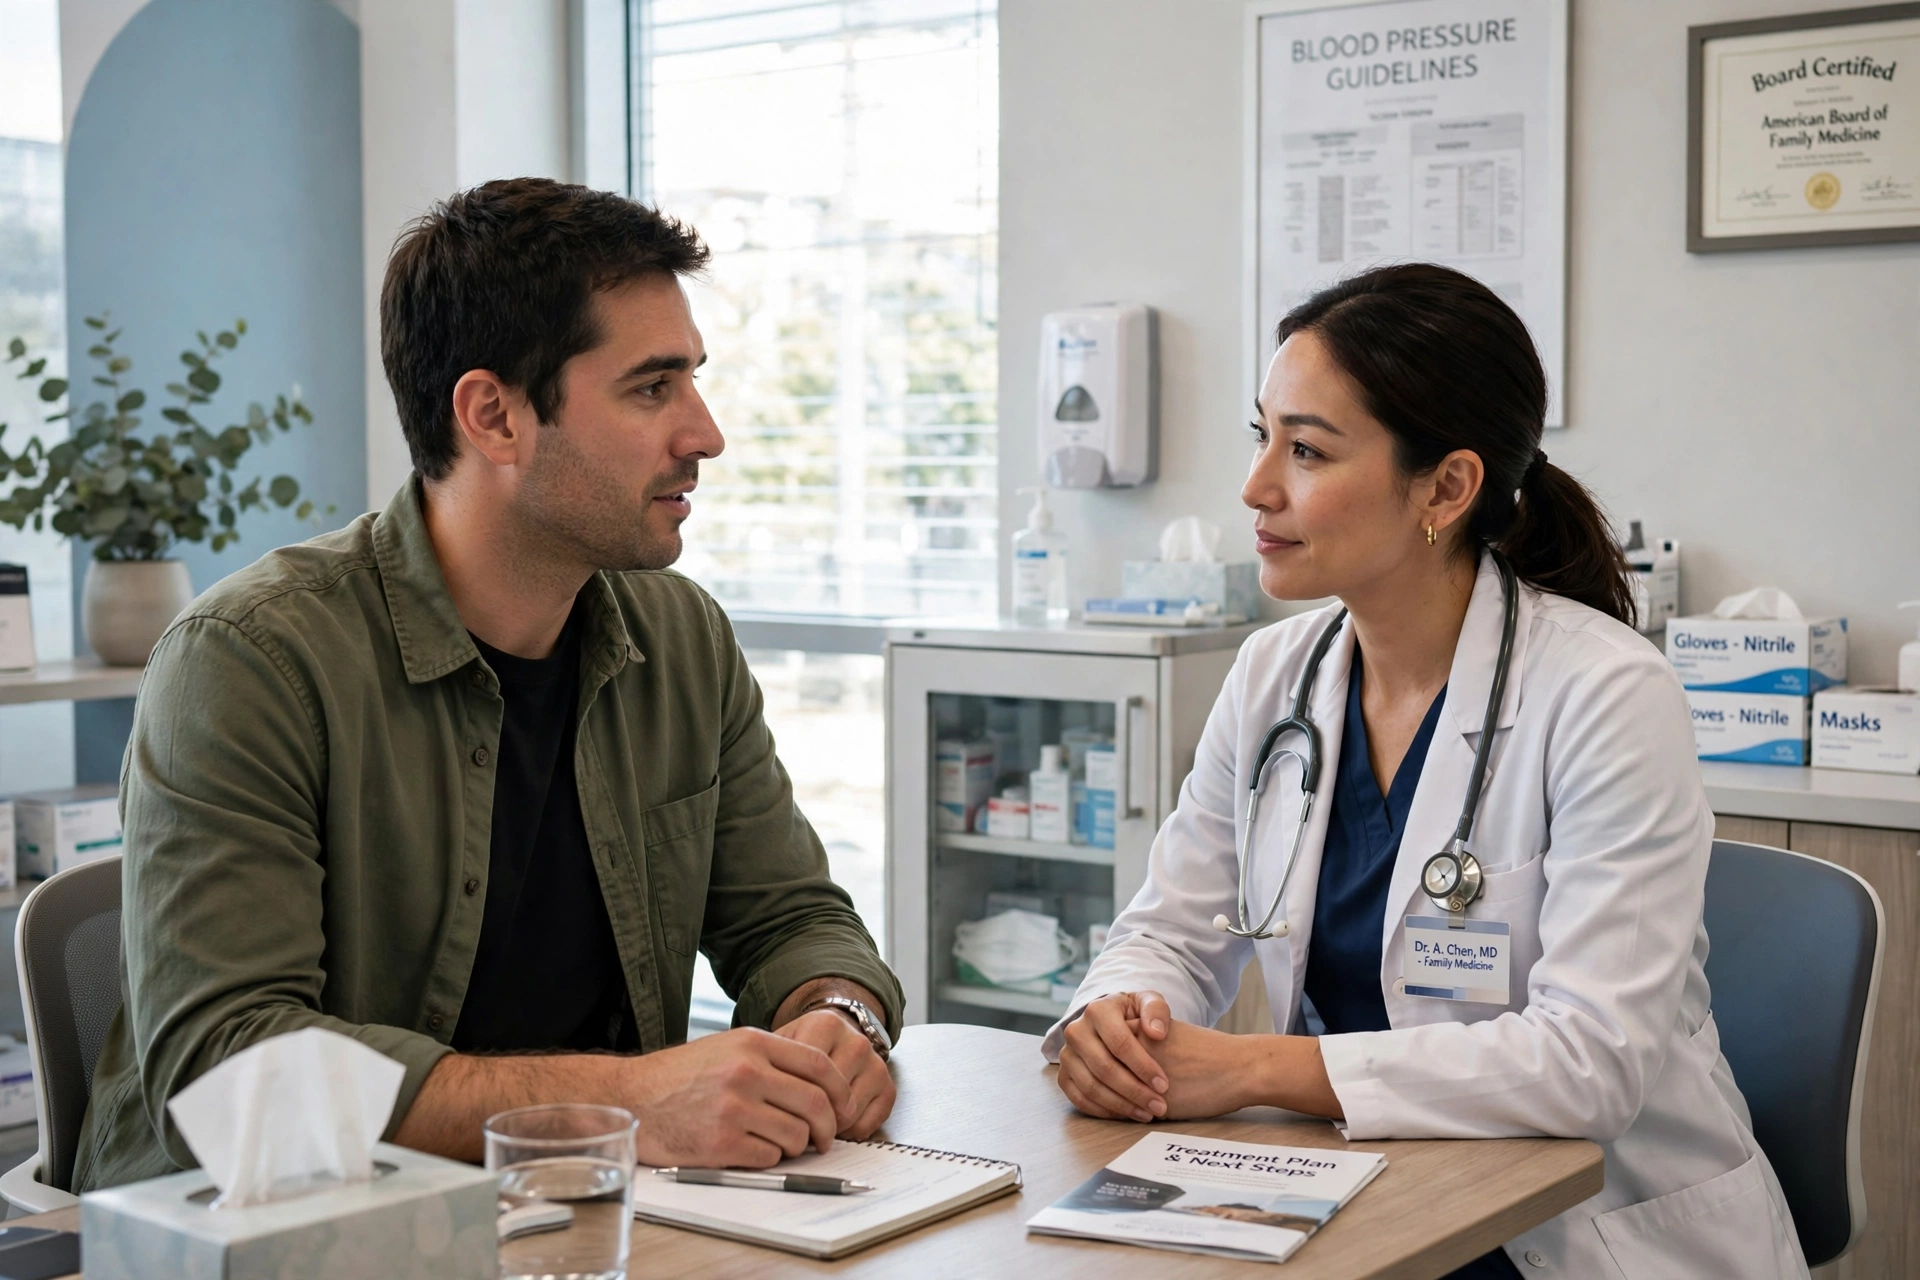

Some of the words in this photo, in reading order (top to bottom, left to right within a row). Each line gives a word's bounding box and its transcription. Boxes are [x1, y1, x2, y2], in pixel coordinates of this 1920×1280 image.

[1292, 32, 1379, 63] BLOOD
[1387, 18, 1518, 53] PRESSURE
[1326, 54, 1479, 91] GUIDELINES
[1752, 59, 1807, 93] Board
[1813, 55, 1898, 82] Certified
[1761, 113, 1825, 130] American
[1829, 106, 1870, 125] Board
[1873, 104, 1889, 121] of
[1769, 131, 1813, 149] Family
[1817, 127, 1881, 144] Medicine
[1674, 633, 1728, 650] Gloves
[1744, 635, 1796, 654] Nitrile
[1690, 707, 1725, 723] oves
[1739, 708, 1790, 726] Nitrile
[1820, 711, 1882, 732] Masks
[1414, 941, 1430, 953] Dr.
[1432, 942, 1444, 955] A.
[1447, 944, 1477, 959] Chen,
[1480, 946, 1498, 958] MD
[1424, 956, 1453, 970] Family
[1454, 959, 1494, 971] Medicine
[1164, 1154, 1181, 1162] &
[1189, 1157, 1245, 1170] Next
[1249, 1163, 1318, 1178] Steps
[1166, 1143, 1281, 1164] Treatment
[1286, 1157, 1337, 1170] Plan
